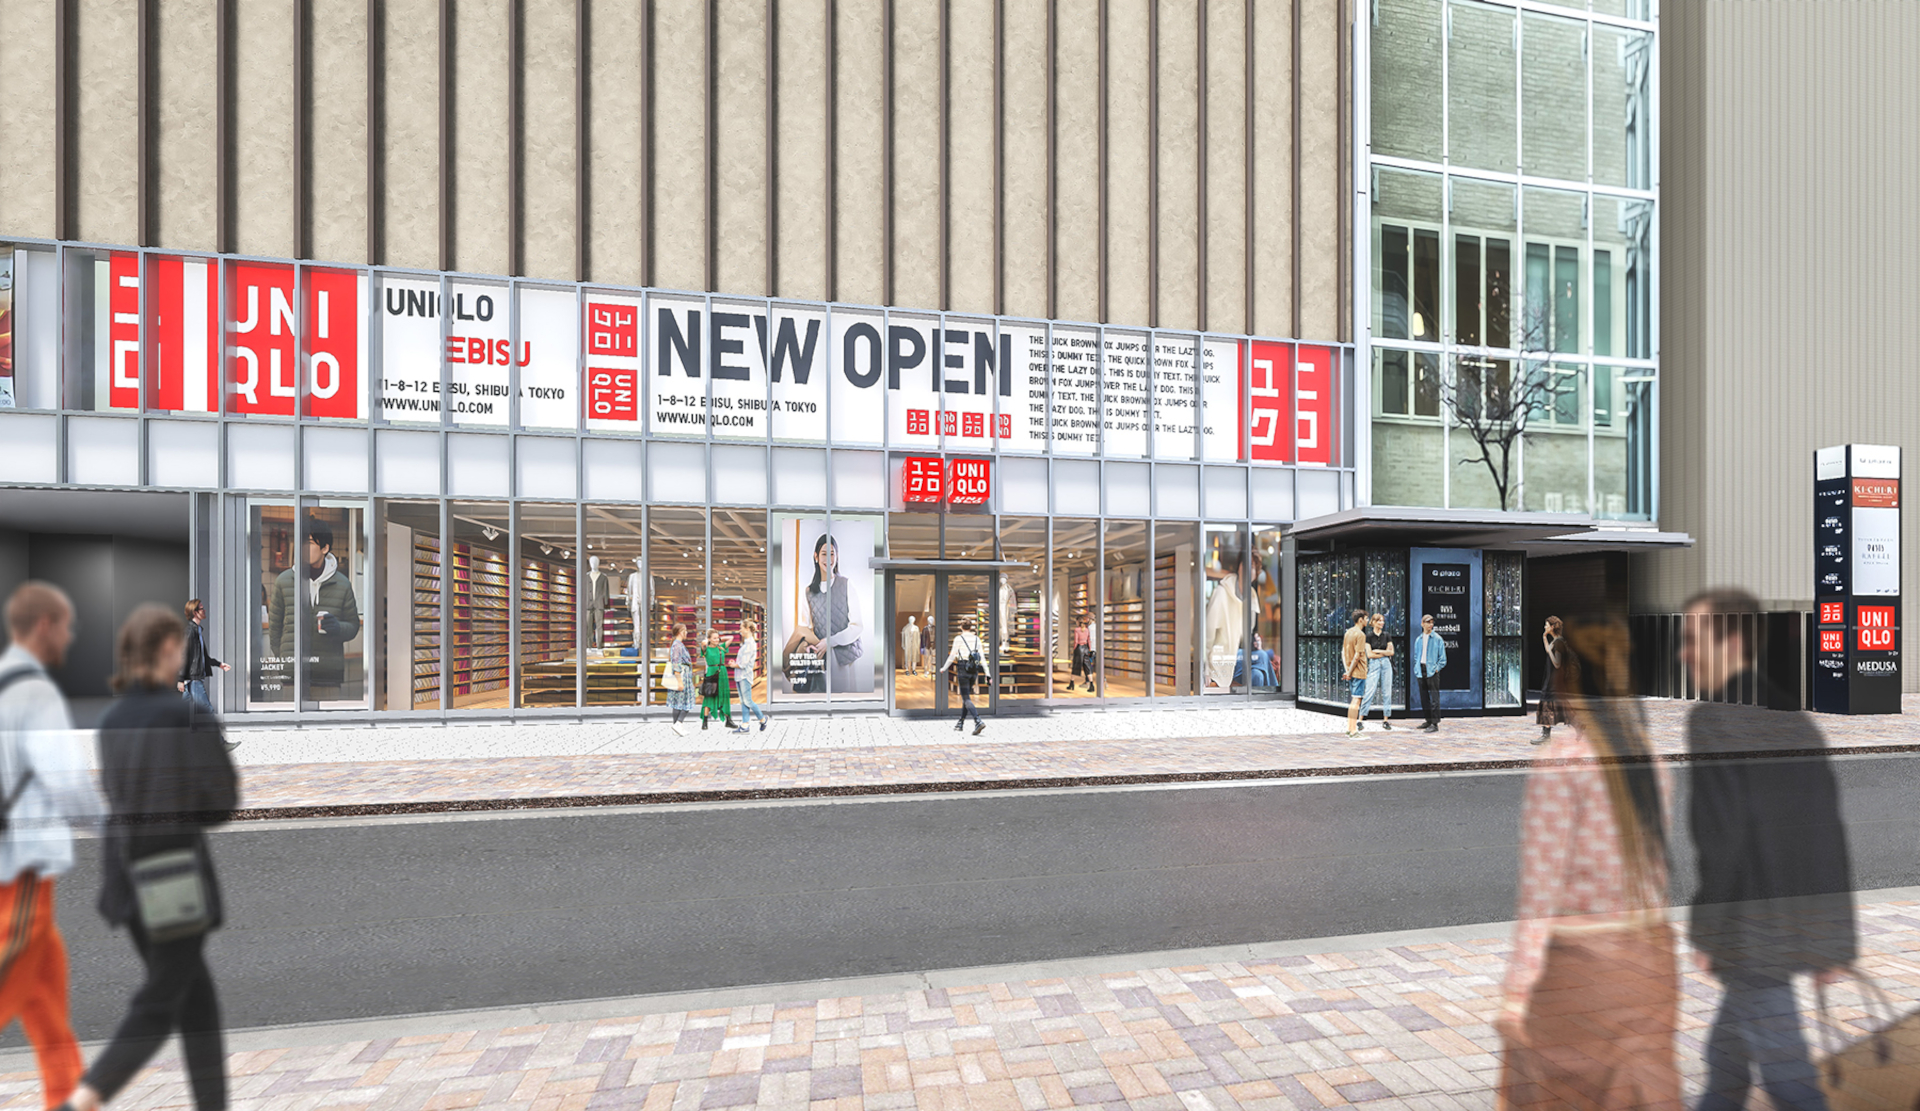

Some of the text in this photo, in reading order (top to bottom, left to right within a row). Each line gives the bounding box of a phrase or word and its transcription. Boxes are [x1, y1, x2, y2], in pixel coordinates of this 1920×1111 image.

[446, 336, 531, 367] EBISU
[658, 308, 1011, 397] NEW OPEN
[1029, 335, 1044, 345] THE
[1051, 337, 1068, 347] UICK
[1070, 339, 1098, 348] BROWN
[1104, 341, 1114, 350] OX
[1115, 342, 1140, 352] JUMPS
[1162, 345, 1177, 355] THE
[1057, 351, 1084, 361] DUMMY
[1108, 355, 1123, 364] THE
[1124, 356, 1146, 366] QUICK
[1175, 360, 1189, 369] FOX
[1067, 366, 1088, 375] LAZY
[1109, 368, 1125, 378] THIS
[1126, 369, 1134, 378] IS
[1162, 372, 1183, 381] TEXT.
[528, 386, 566, 400] TOKYO
[1058, 378, 1073, 388] FOX
[1122, 382, 1137, 391] THE
[1178, 385, 1194, 395] THIS
[1057, 391, 1078, 402] TEXT.
[1080, 392, 1095, 402] THE
[784, 401, 817, 414] TOKYO
[1029, 403, 1044, 413] THE
[1052, 405, 1067, 414] AZY
[1068, 406, 1086, 415] DOG.
[1115, 408, 1140, 418] DUMMY
[1029, 417, 1044, 427] THE
[1051, 418, 1068, 428] UICK
[1104, 421, 1114, 430] OX
[1115, 421, 1140, 431] JUMPS
[1162, 424, 1177, 434] THE
[1057, 433, 1084, 442] DUMMY
[957, 463, 985, 478] UNI
[957, 479, 988, 495] QLO
[1861, 611, 1888, 627] UNI
[1823, 633, 1840, 641] UNI
[1861, 629, 1891, 648] QLO
[1823, 641, 1841, 650] QLO
[260, 663, 285, 671] JACKET
[1857, 661, 1898, 671] MEDUSA
